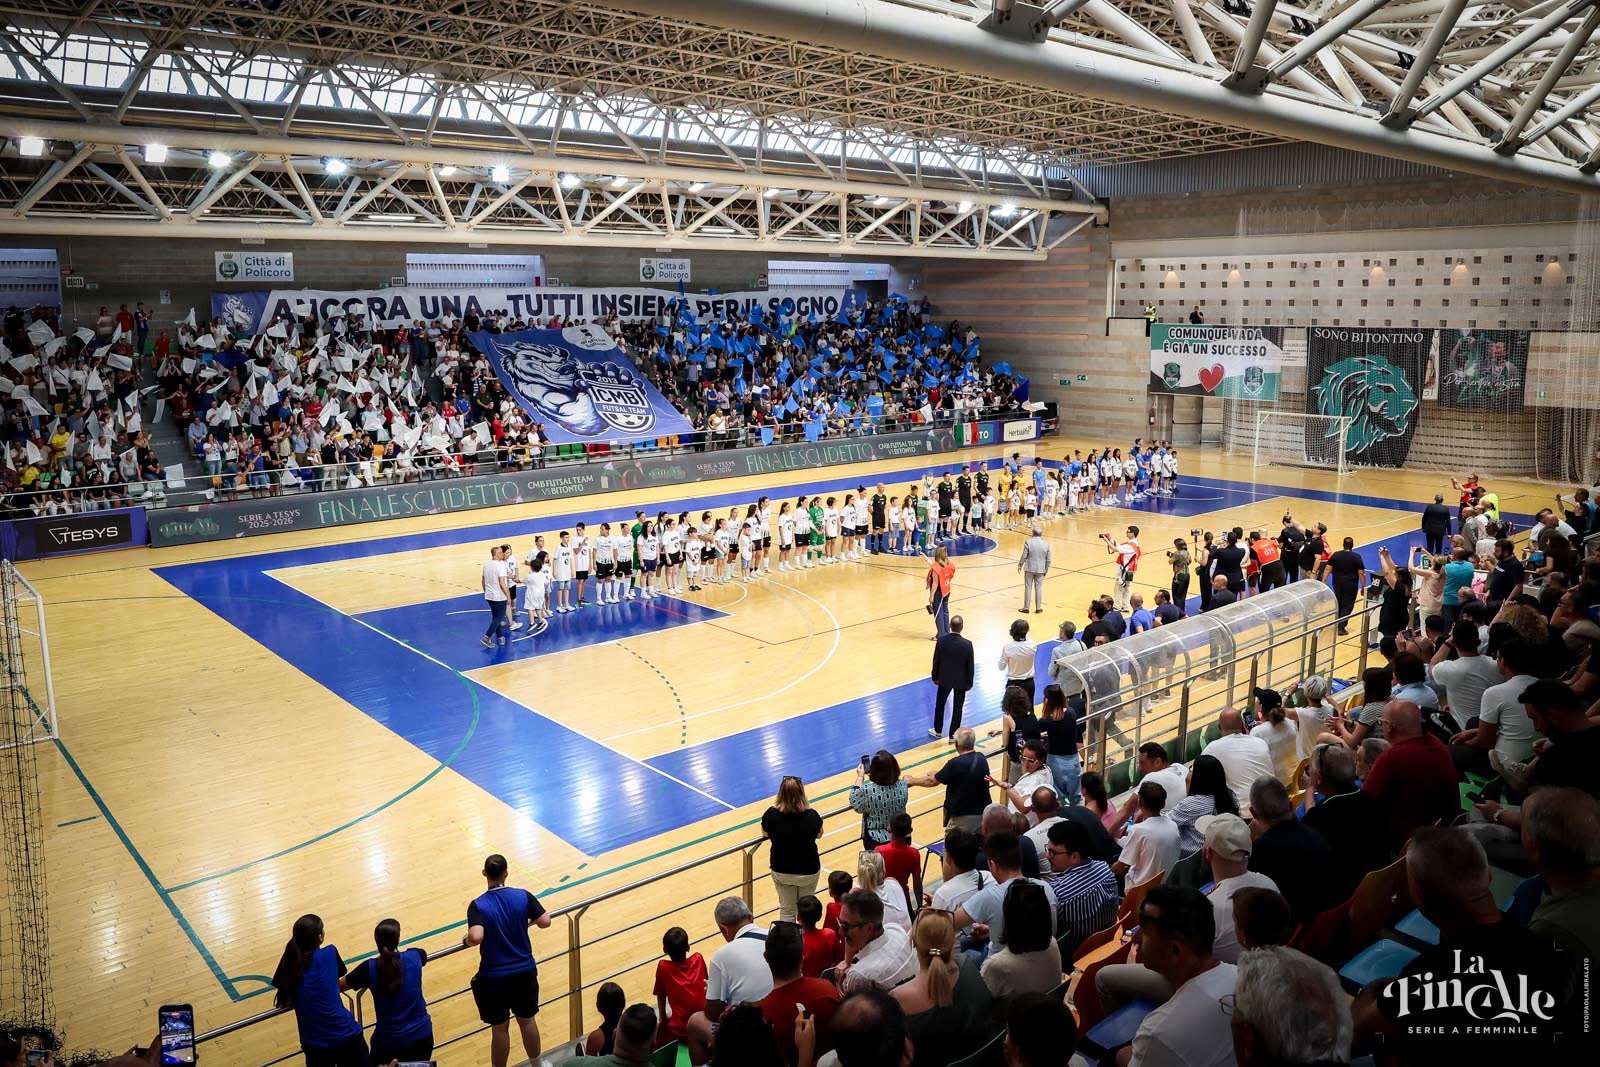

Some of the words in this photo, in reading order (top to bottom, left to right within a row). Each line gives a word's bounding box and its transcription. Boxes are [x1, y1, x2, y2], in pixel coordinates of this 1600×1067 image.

[244, 256, 272, 266] Città
[274, 256, 285, 266] di
[678, 262, 686, 270] di
[245, 267, 291, 277] Policoro
[659, 270, 689, 279] Policoro
[695, 298, 739, 321] PER
[768, 295, 839, 319] SOGNO
[1168, 326, 1228, 341] COMUNQUE
[1229, 328, 1263, 342] VADA
[1315, 327, 1349, 341] SONO
[1351, 331, 1424, 344] BITONTINO
[1172, 340, 1190, 354] GIÀ
[1193, 342, 1208, 355] UN
[1211, 342, 1267, 357] SUCCESSO
[595, 375, 619, 384] 2013
[602, 404, 626, 412] FUTSAL
[627, 406, 647, 415] TEAM
[527, 480, 546, 489] CMB
[571, 474, 594, 483] TEAM
[550, 484, 584, 495] BITONTO
[238, 513, 265, 523] SERIE
[273, 509, 301, 519] TESYS
[248, 517, 294, 529] 2025-2026
[61, 526, 118, 543] TESYS
